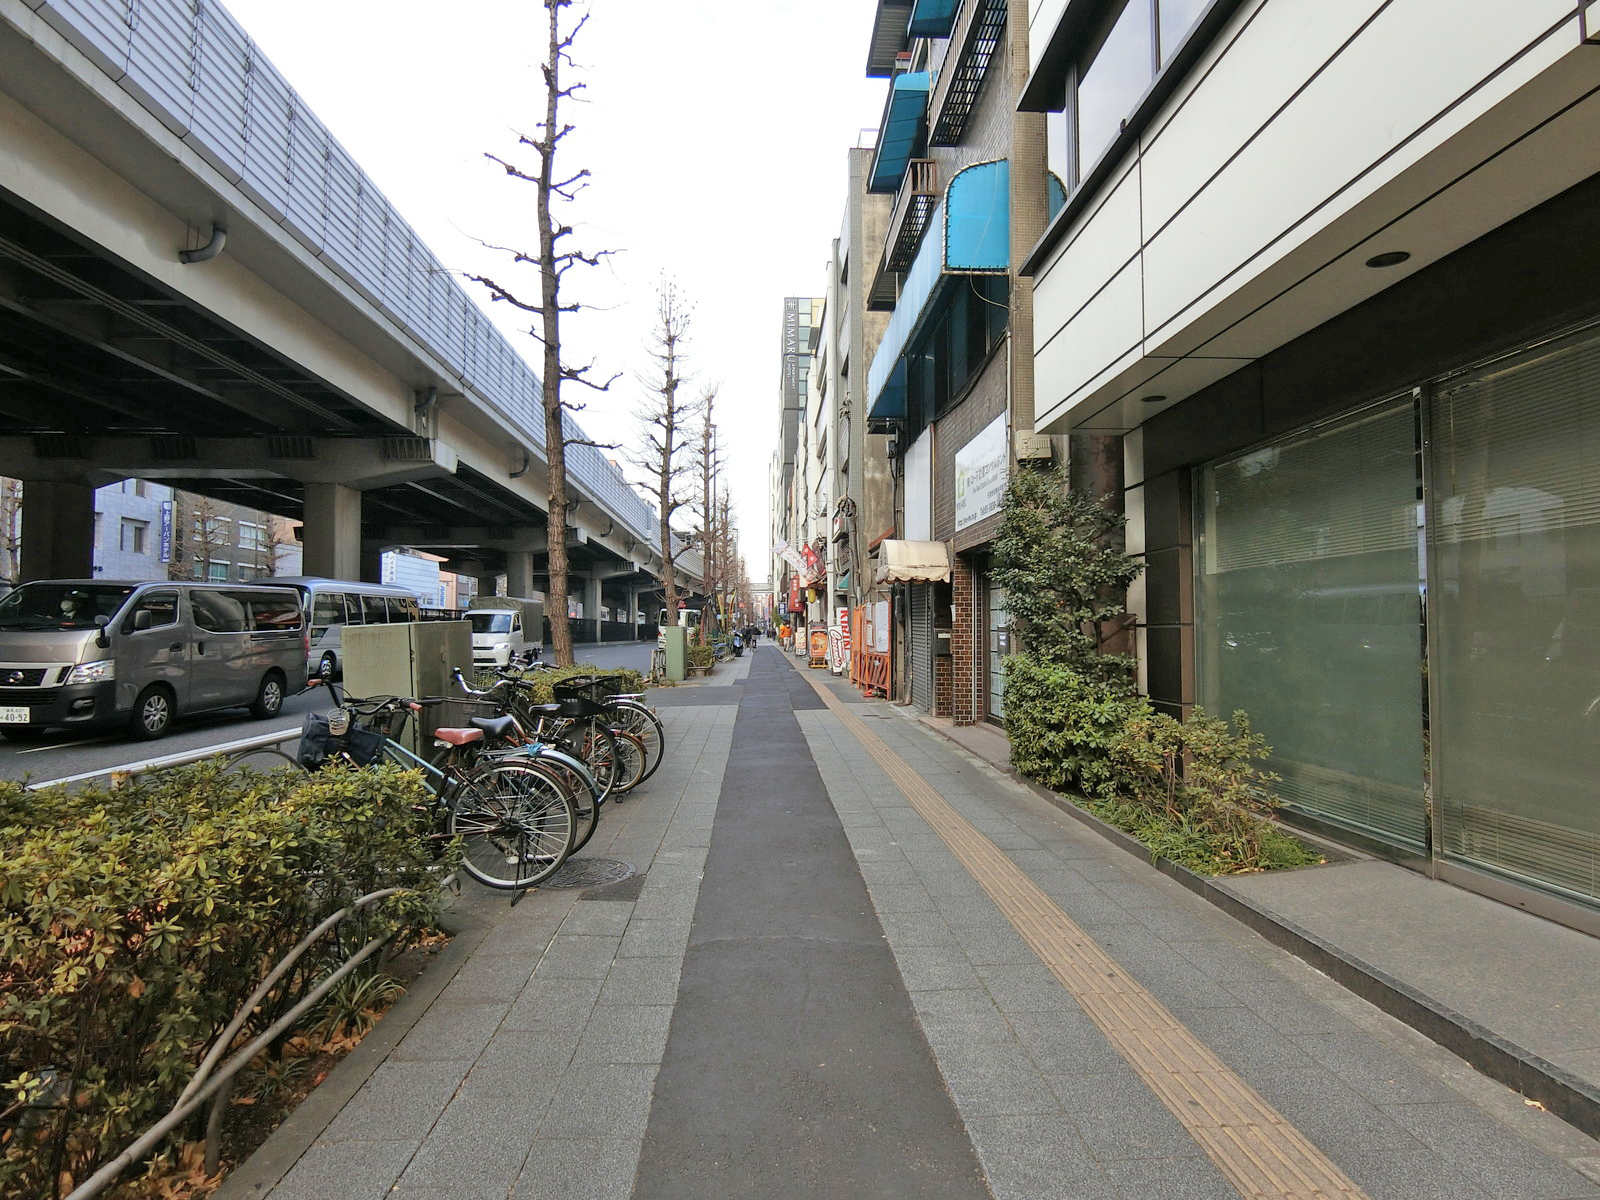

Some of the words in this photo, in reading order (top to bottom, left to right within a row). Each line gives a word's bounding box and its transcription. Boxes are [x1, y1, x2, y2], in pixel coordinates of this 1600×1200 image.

[787, 313, 796, 363] MIMARU
[163, 510, 171, 558] 上野アーバンホテル
[840, 610, 851, 650] KIRIN
[5, 713, 28, 722] 40-92
